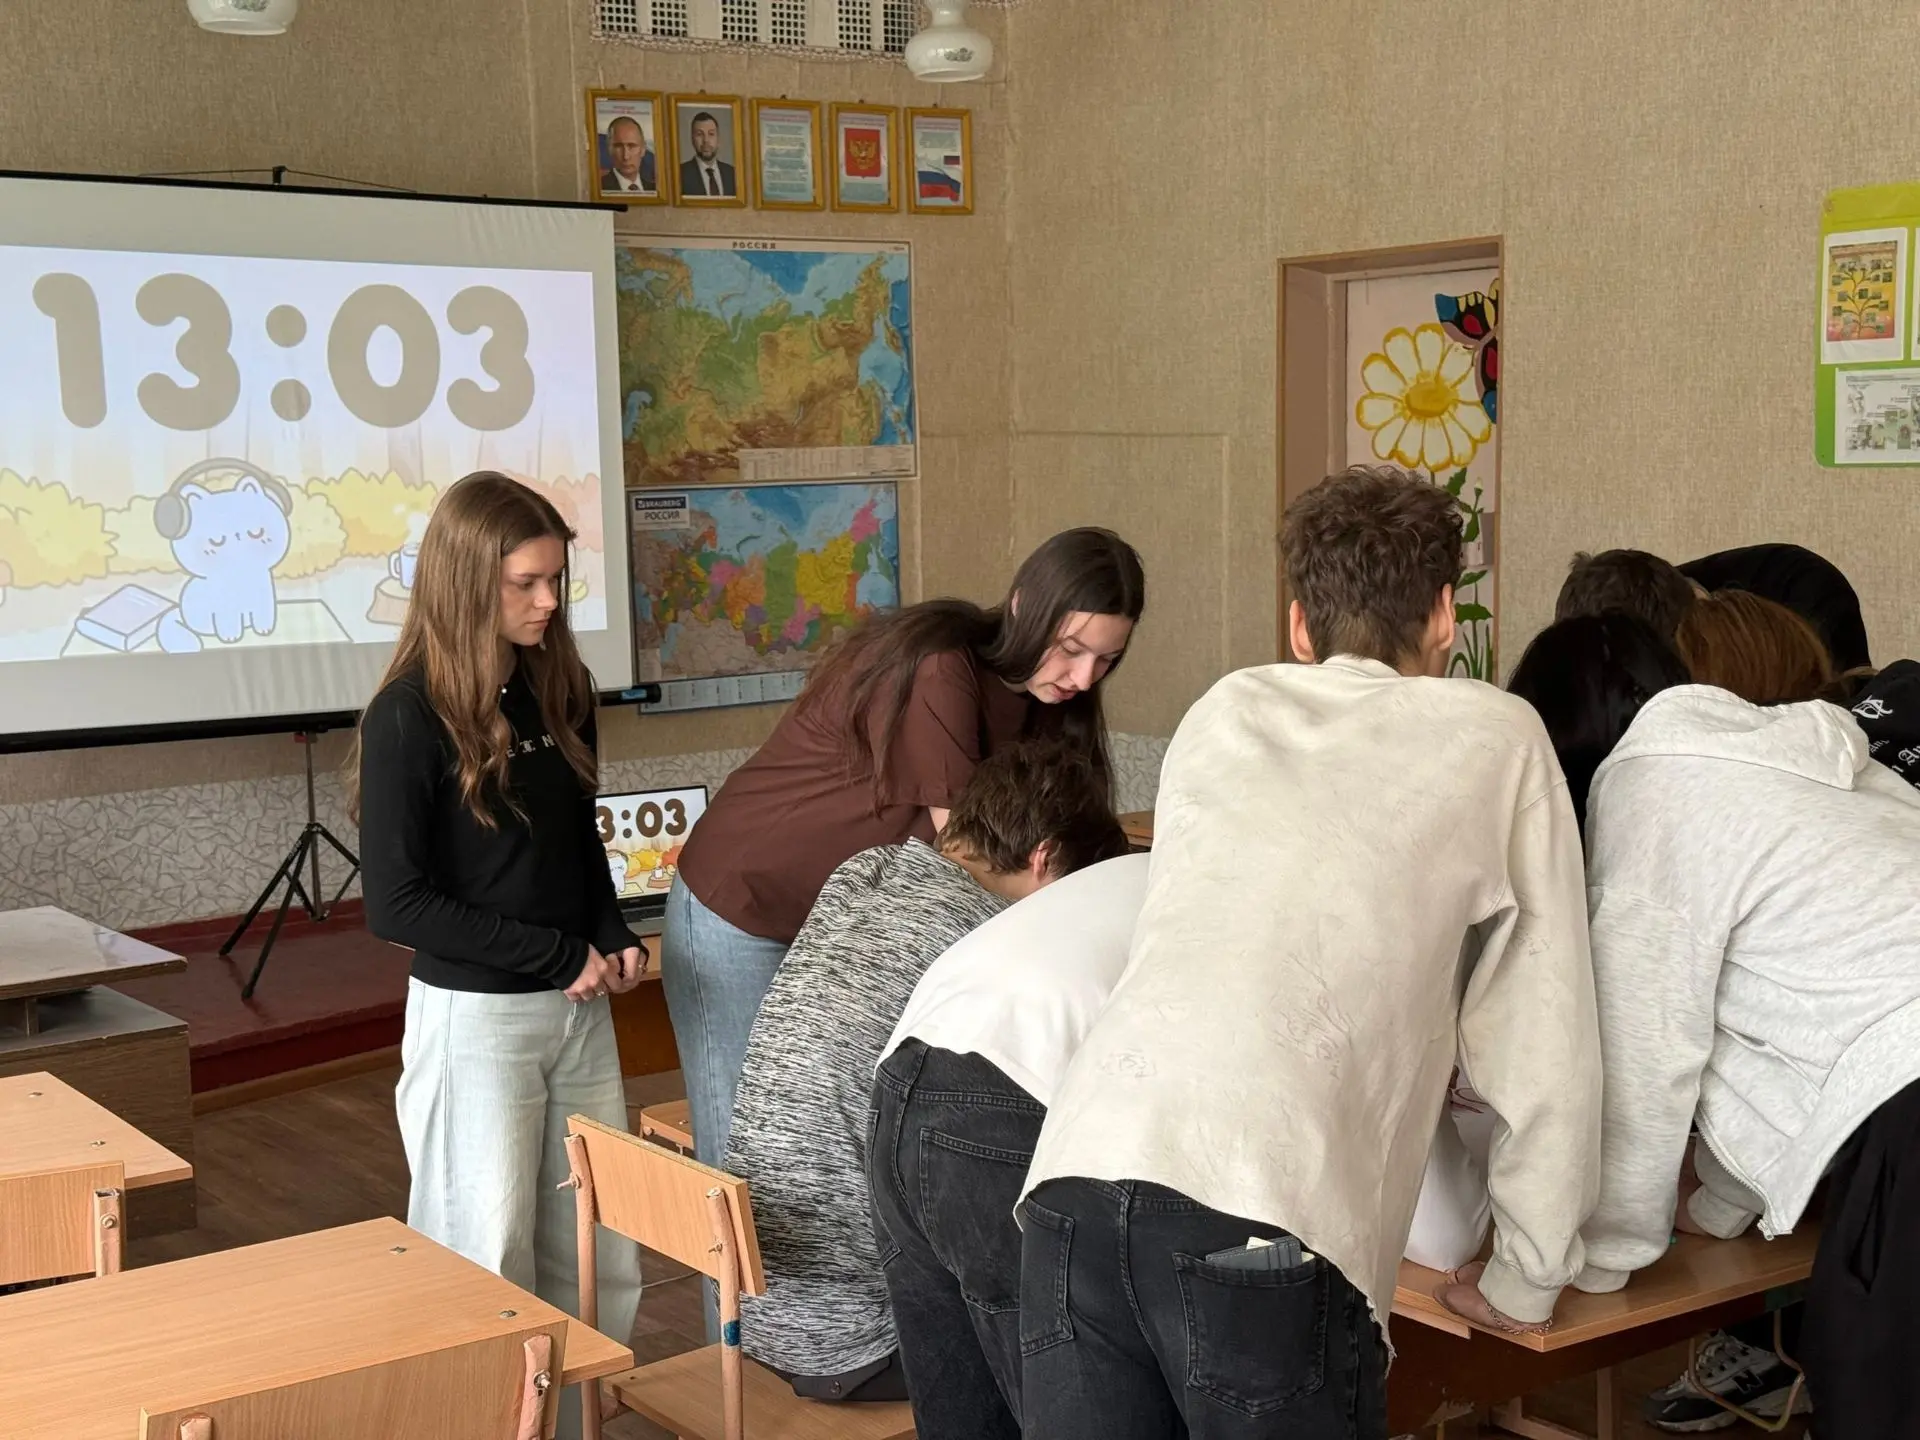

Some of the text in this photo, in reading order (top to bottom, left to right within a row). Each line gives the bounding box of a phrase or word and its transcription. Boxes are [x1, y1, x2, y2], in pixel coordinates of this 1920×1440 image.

[732, 241, 776, 249] РОССИЯ
[32, 272, 535, 431] 13:03
[644, 510, 680, 520] РОССИЯ
